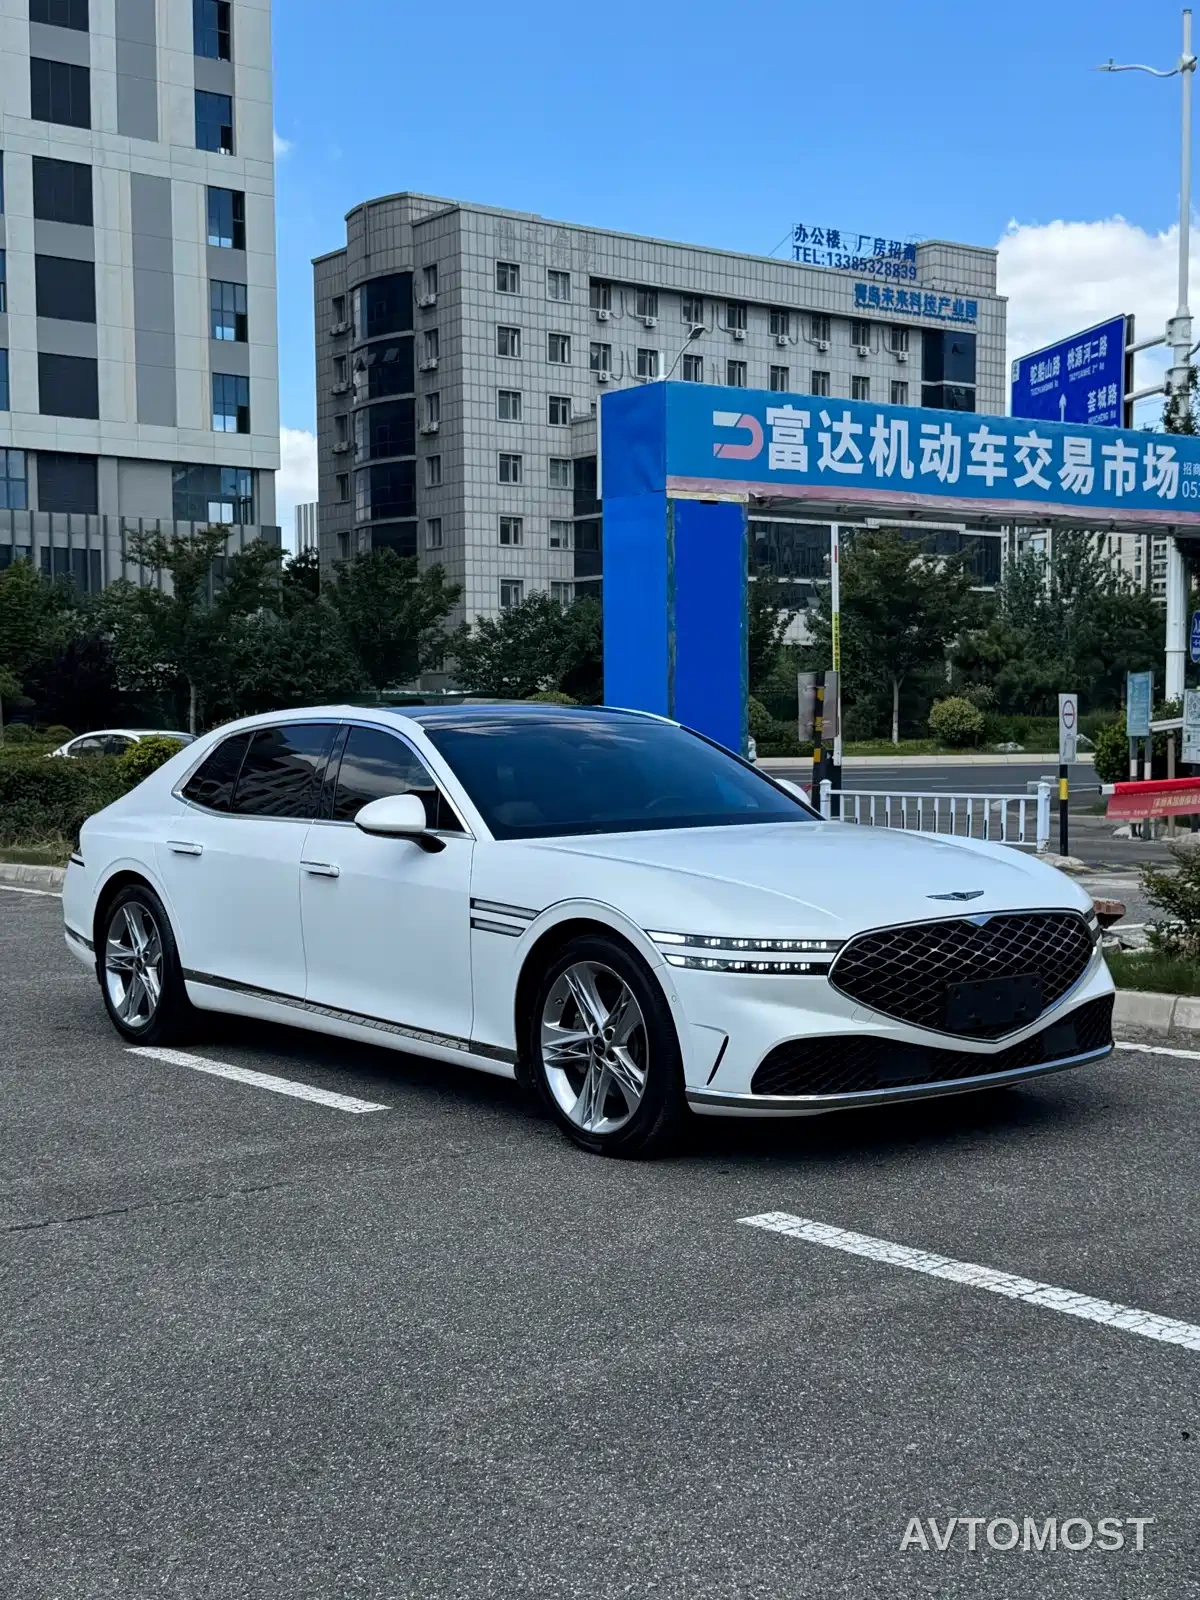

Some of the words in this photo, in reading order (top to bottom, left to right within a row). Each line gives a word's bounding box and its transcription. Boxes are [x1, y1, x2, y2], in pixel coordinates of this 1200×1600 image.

[794, 223, 916, 263] 办公楼、厂房招商
[792, 245, 917, 281] TEL:13385328839
[854, 283, 978, 319] 青岛未来科技产业园
[1067, 334, 1107, 371] 桃源河二路
[1087, 382, 1117, 413] 荟城路
[765, 404, 1180, 500] 富达机动车交易市场
[1182, 480, 1200, 499] 05
